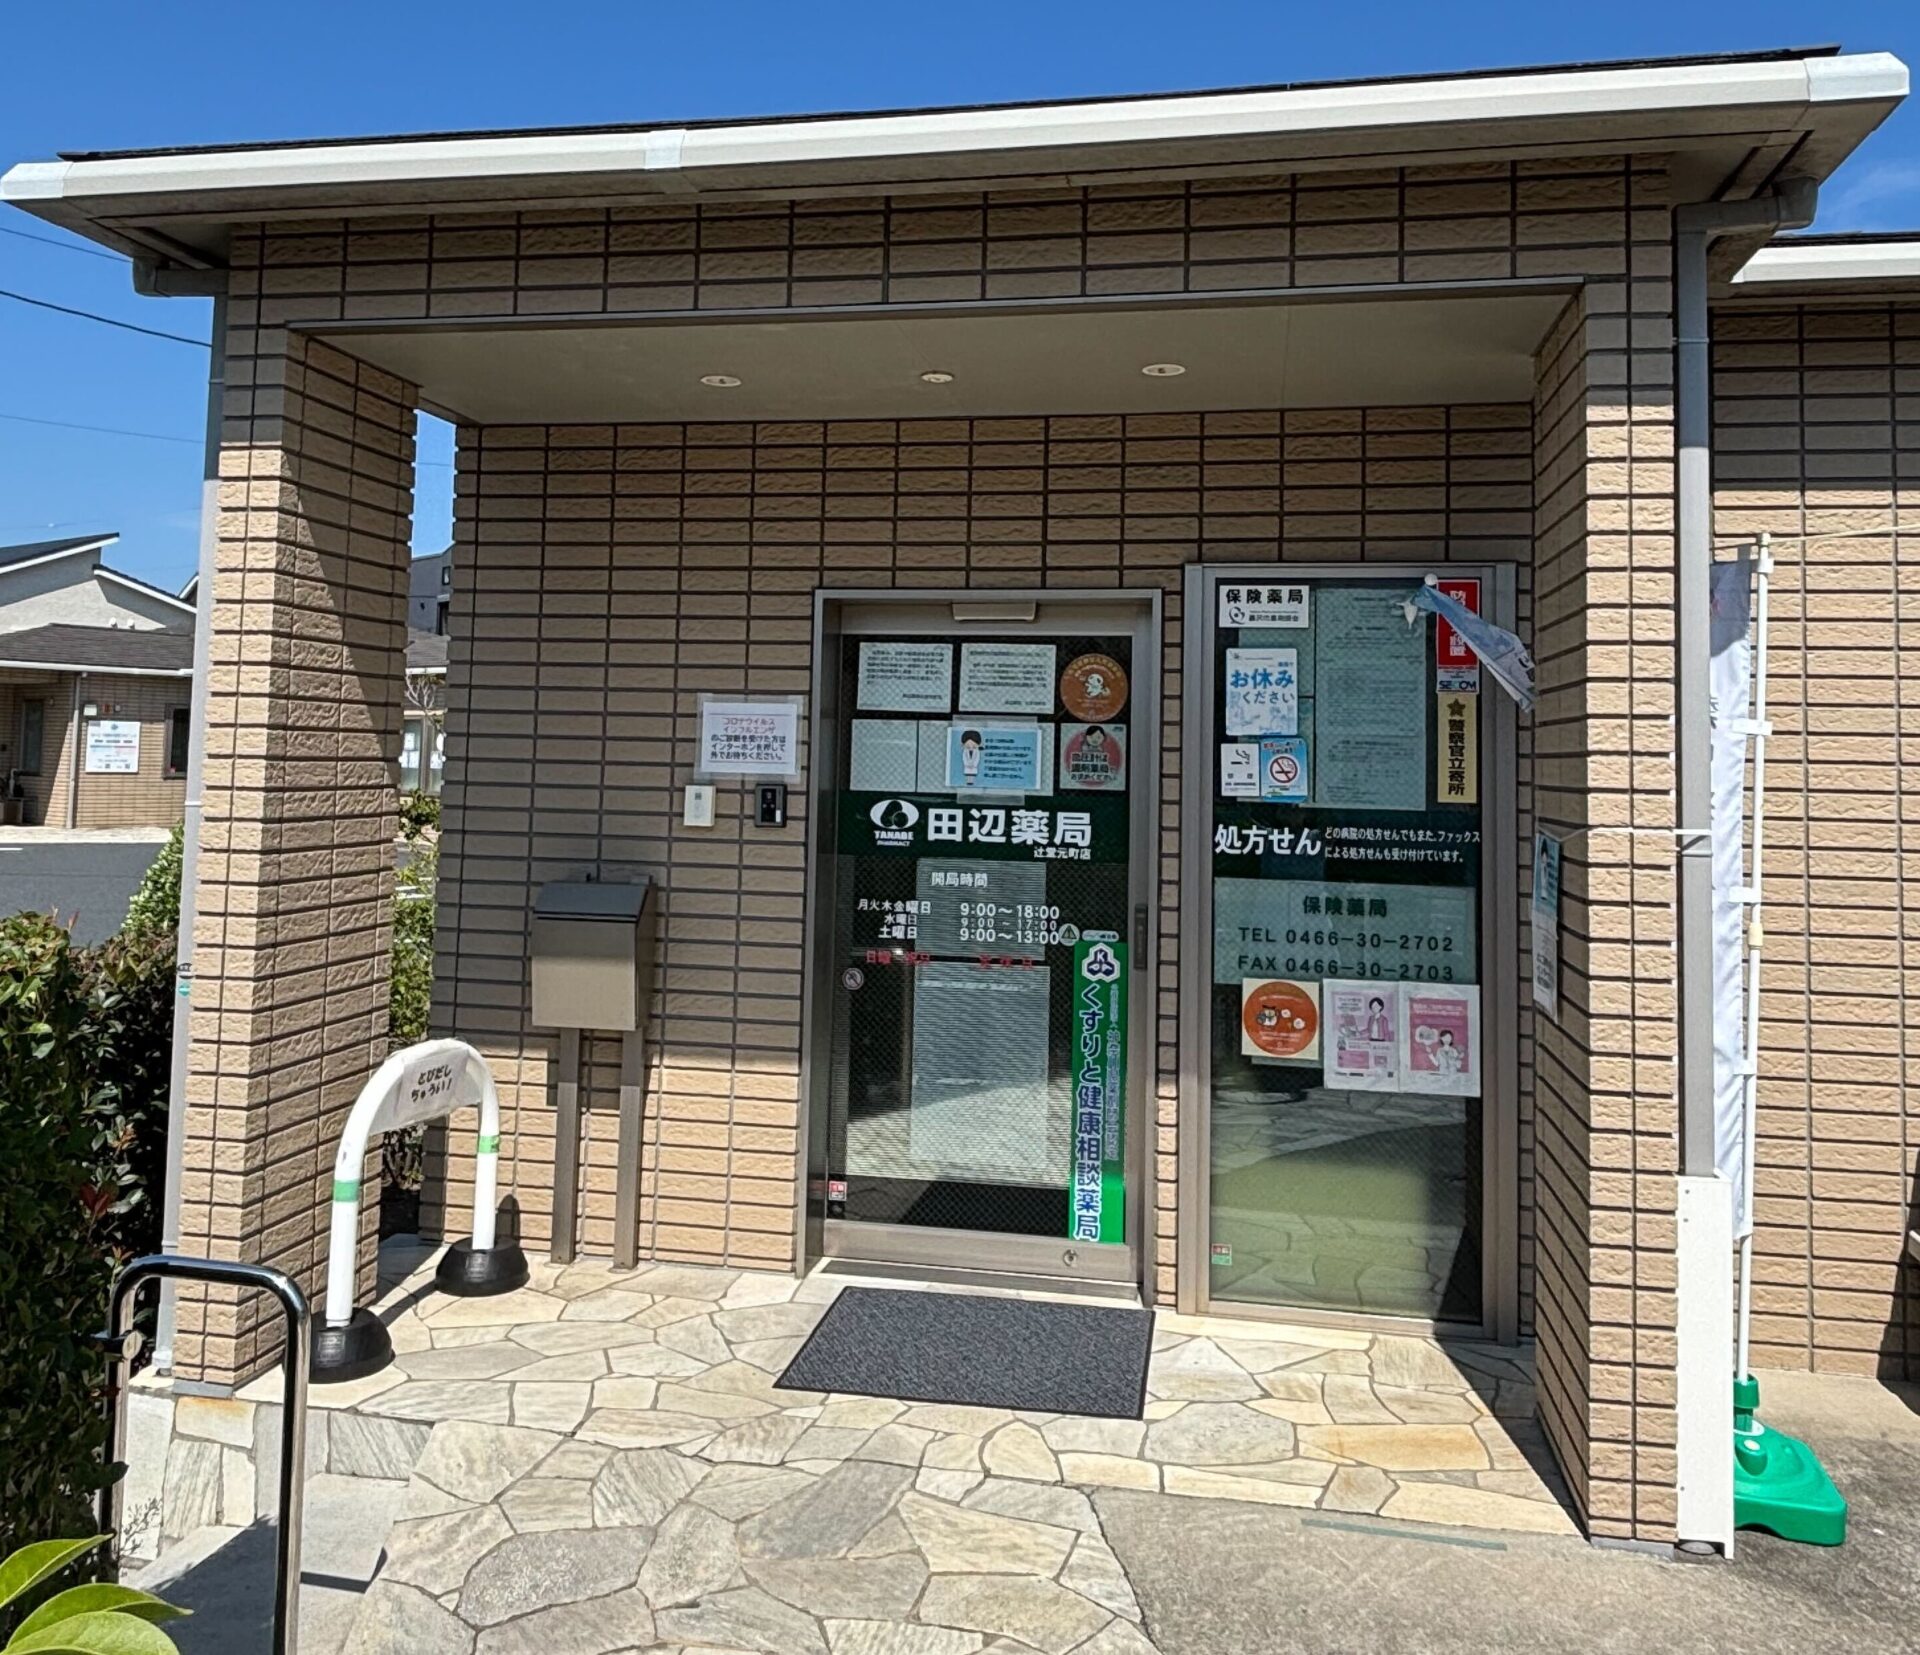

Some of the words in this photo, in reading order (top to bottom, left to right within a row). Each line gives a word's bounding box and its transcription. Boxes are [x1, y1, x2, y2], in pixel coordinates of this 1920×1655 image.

[1226, 588, 1304, 605] 保険薬局
[1230, 668, 1294, 690] お休み
[1242, 690, 1295, 705] ください
[874, 830, 914, 841] TANABE
[927, 808, 1092, 847] 田辺薬局
[1214, 823, 1322, 856] 処方せん
[930, 871, 988, 888] 開局時間
[857, 898, 931, 915] 月火木金曜日
[1303, 896, 1388, 918] 保険薬局
[884, 912, 918, 926] 水曜日
[878, 925, 918, 940] 土曜日
[1238, 927, 1277, 943] TEL
[1238, 955, 1278, 971] FAX
[417, 1064, 452, 1086] とびだし
[1074, 982, 1104, 1241] くすりと健康相談薬局
